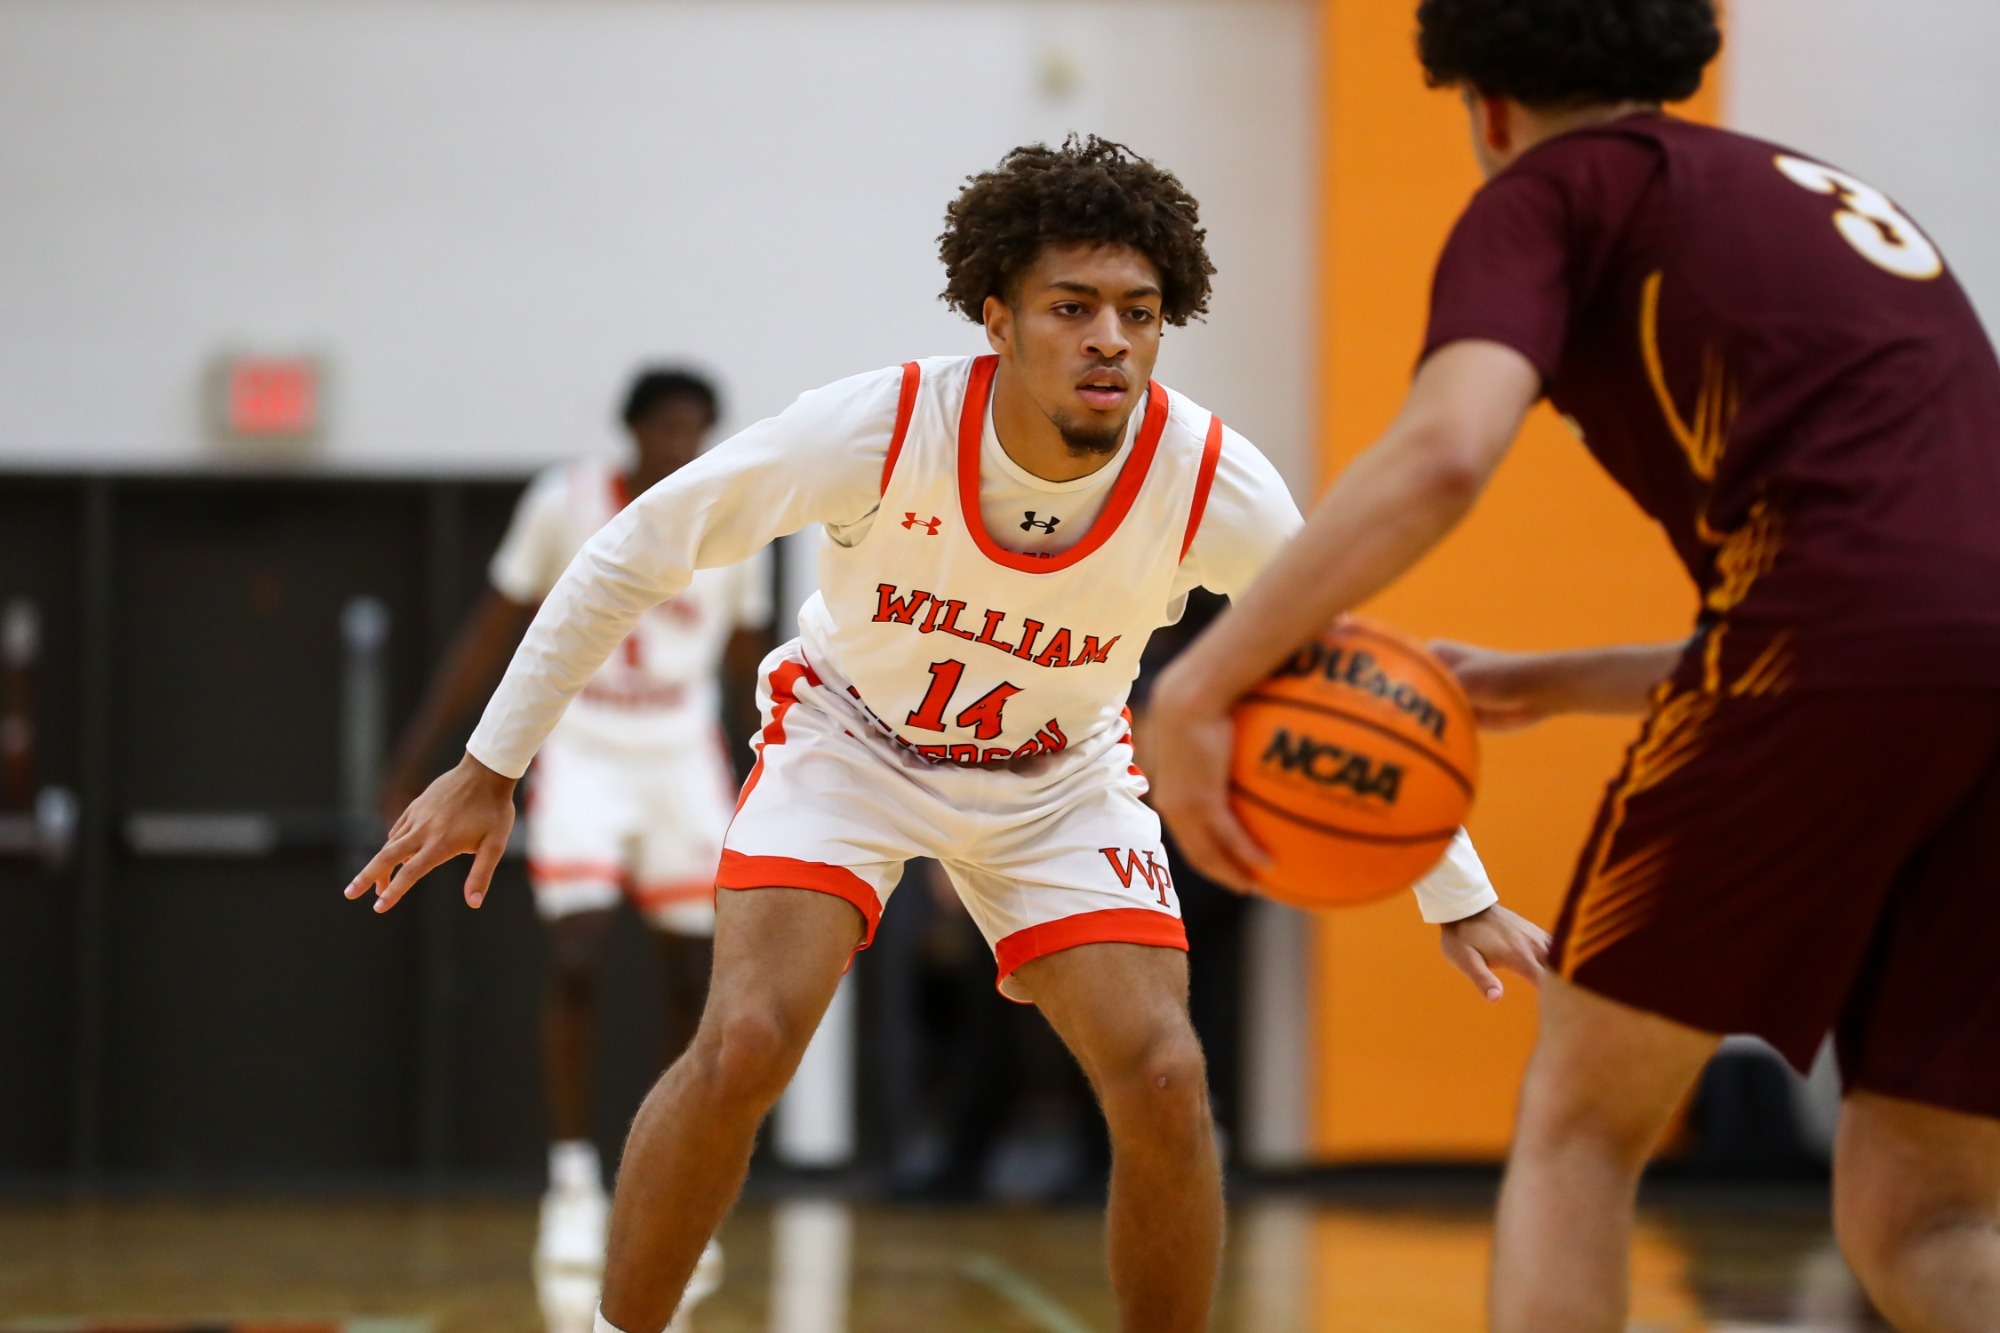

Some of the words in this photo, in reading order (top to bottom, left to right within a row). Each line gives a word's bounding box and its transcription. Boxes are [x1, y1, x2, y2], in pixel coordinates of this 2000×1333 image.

[1772, 154, 1943, 281] 3
[871, 583, 1123, 668] WILLIAM
[905, 658, 1025, 741] 14
[1261, 728, 1403, 804] NCAA
[1098, 847, 1171, 908] WP
